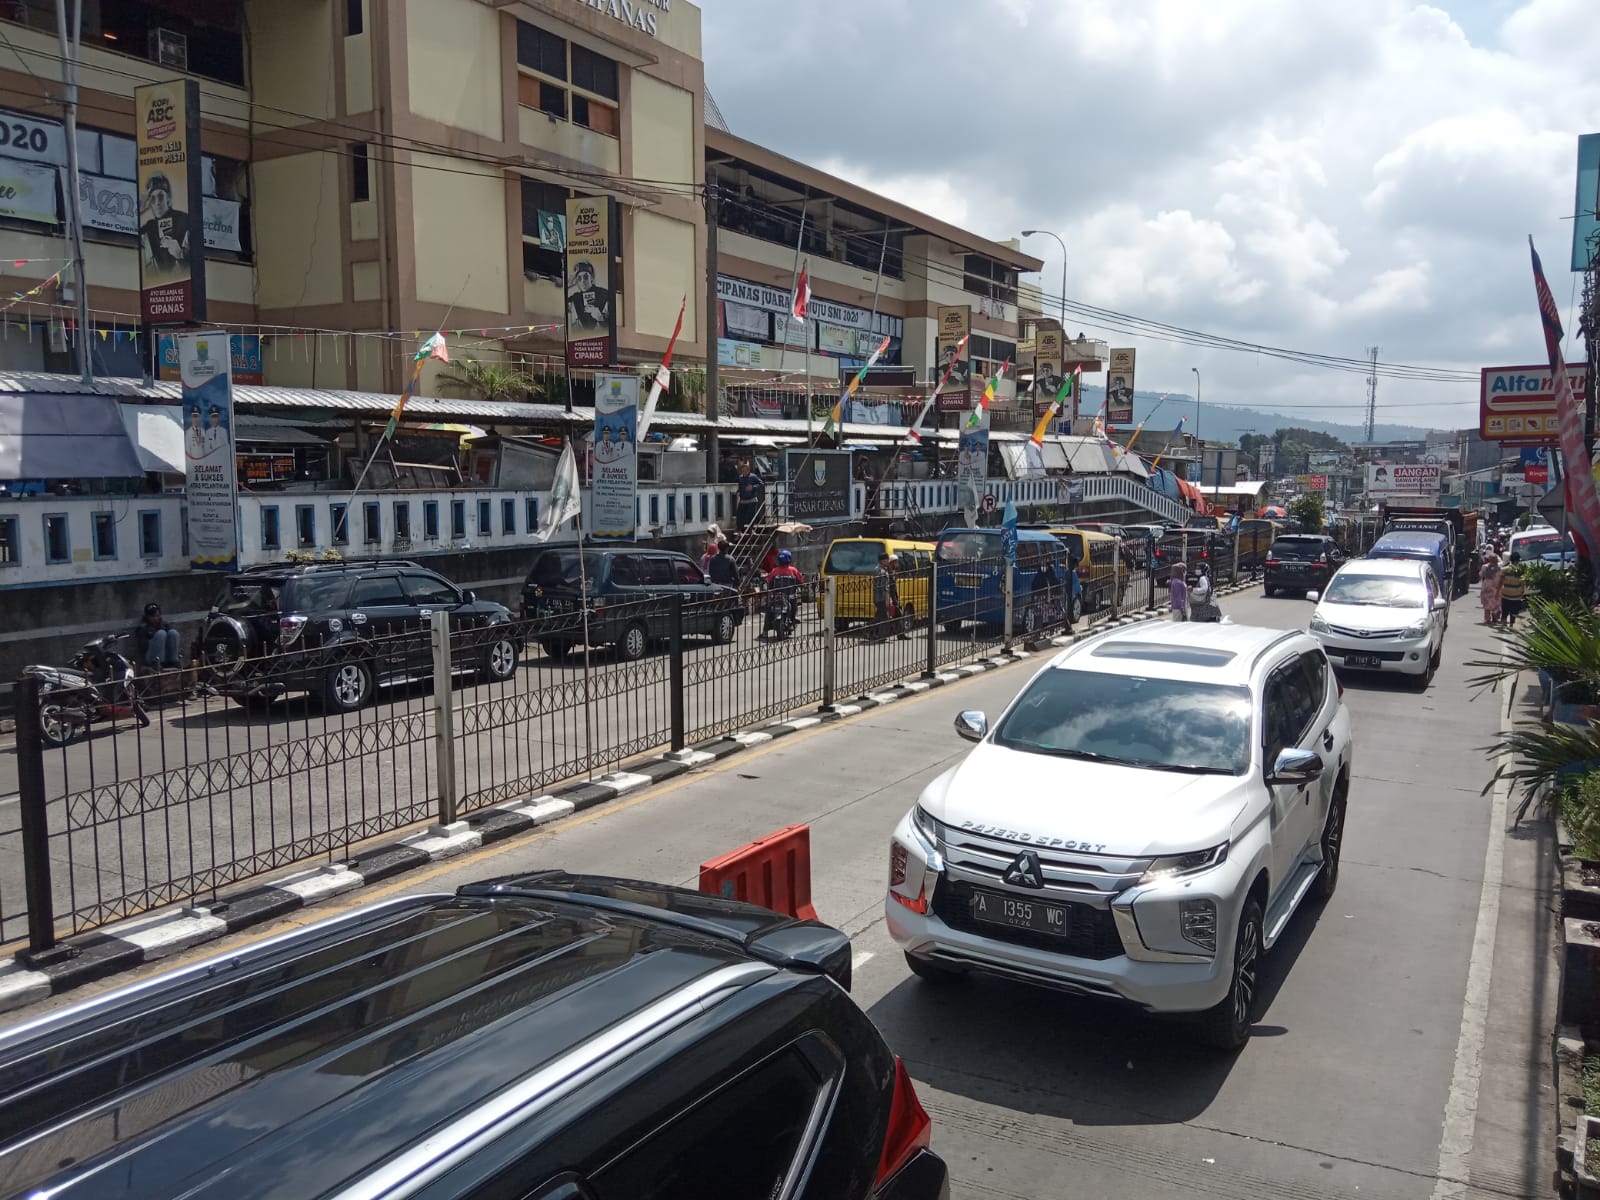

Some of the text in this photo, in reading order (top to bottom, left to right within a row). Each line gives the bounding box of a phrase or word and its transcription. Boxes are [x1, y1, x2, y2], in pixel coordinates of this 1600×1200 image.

[577, 0, 657, 36] PANAS
[152, 98, 169, 108] KOPI
[147, 106, 174, 123] ABC
[576, 214, 598, 225] ABC
[717, 281, 760, 302] CIPANAS
[761, 290, 791, 309] JUARA
[827, 307, 842, 319] SNI
[843, 310, 859, 323] 2020
[150, 303, 185, 314] CIPANAS
[194, 465, 222, 473] SELAMAT
[1395, 468, 1436, 477] JANGAN
[200, 474, 224, 482] SUKSES
[794, 501, 816, 513] PASAR
[961, 820, 1107, 852] PAJERO SPORT
[979, 895, 1063, 926] A 1355 WC
